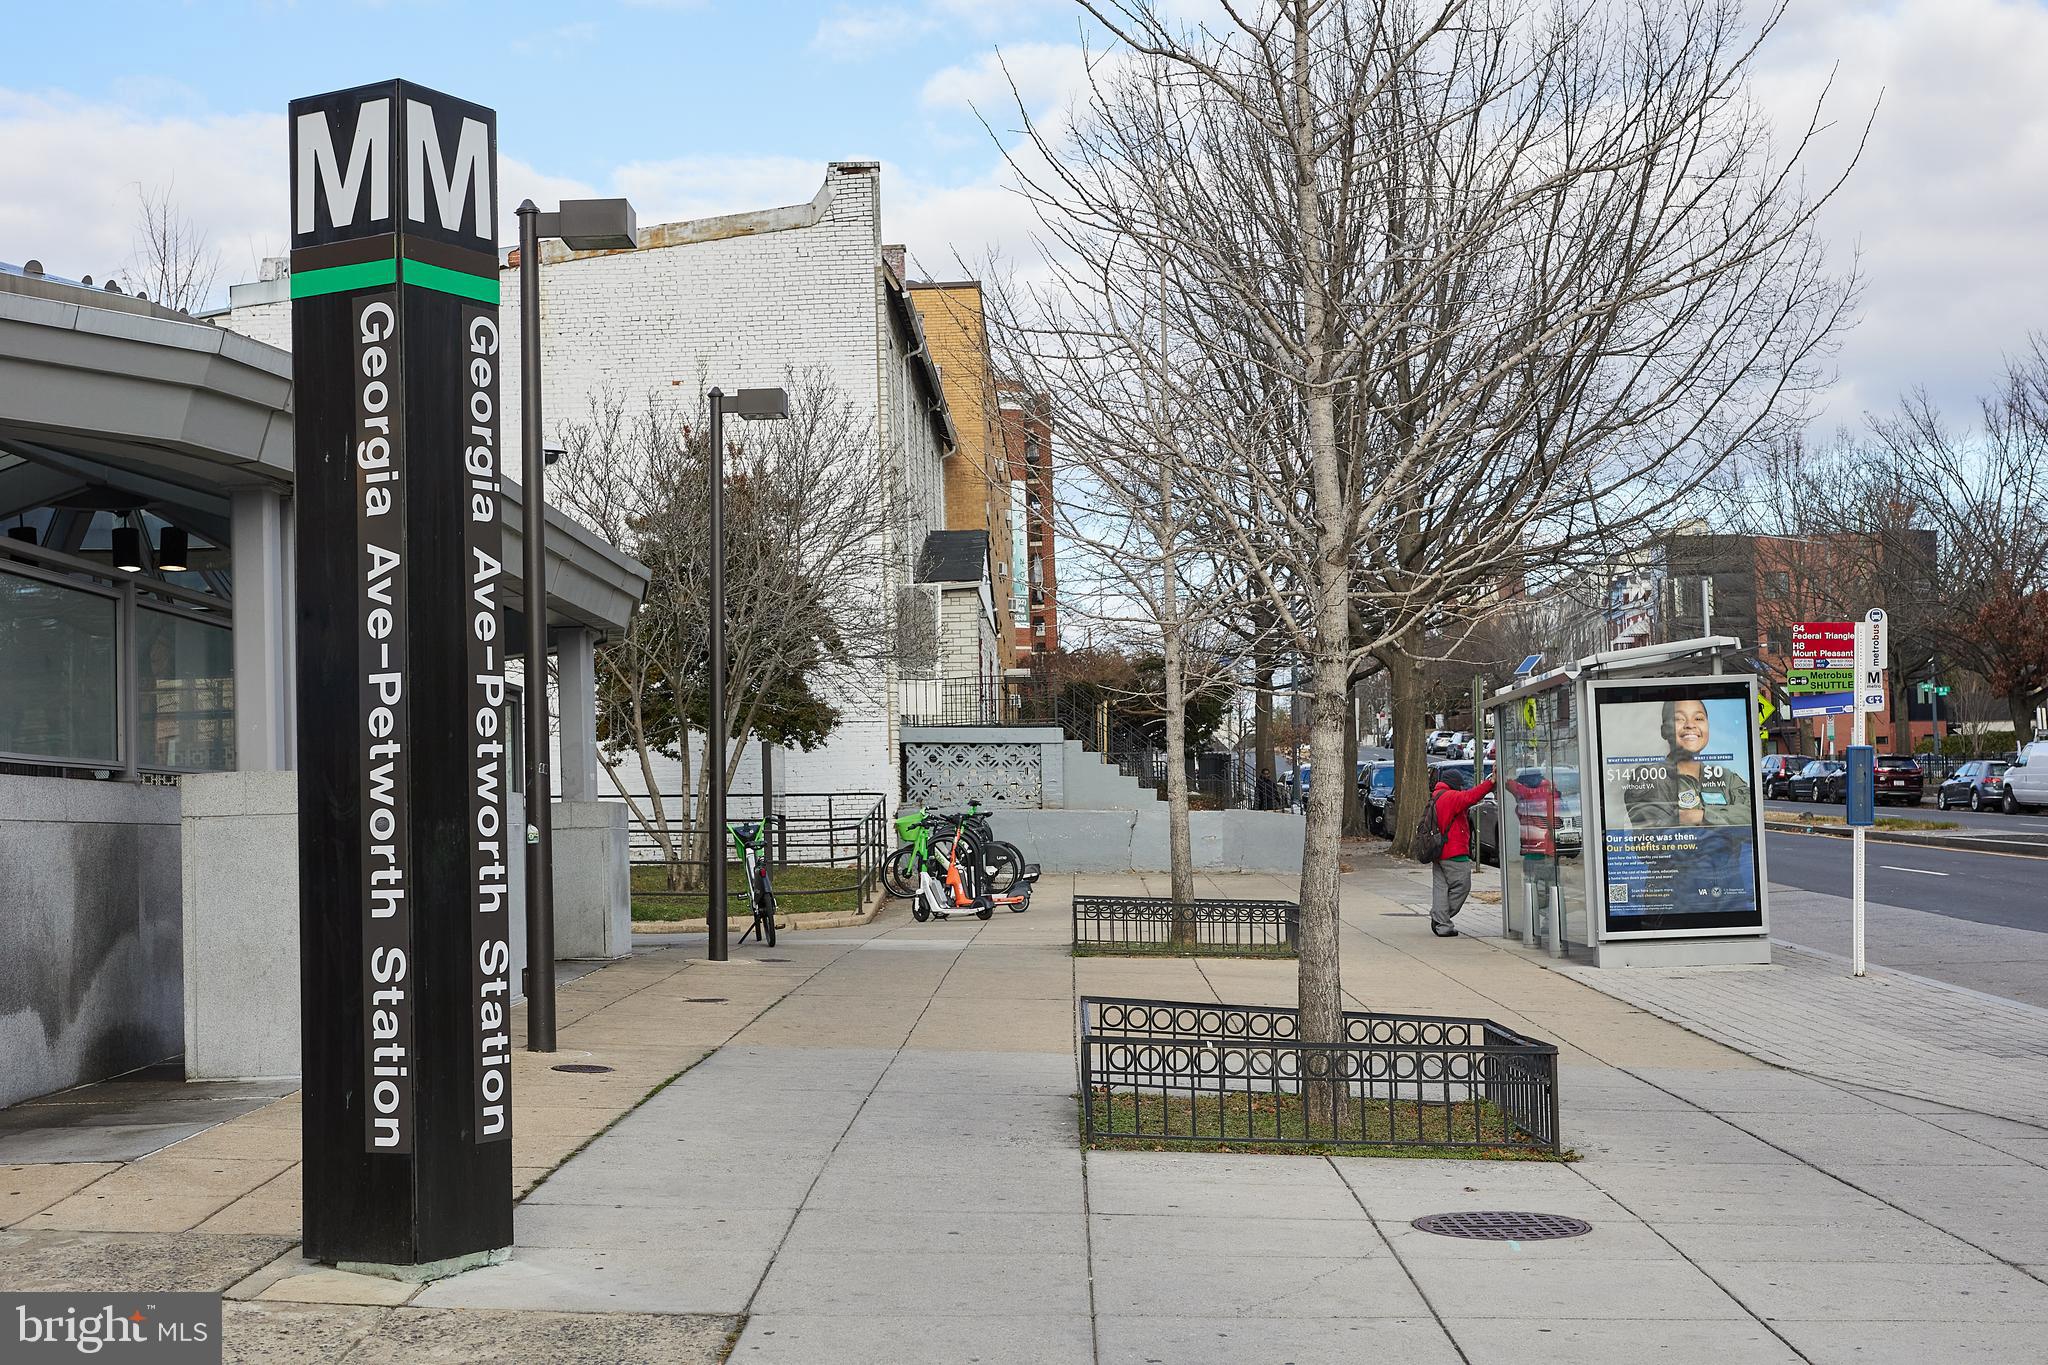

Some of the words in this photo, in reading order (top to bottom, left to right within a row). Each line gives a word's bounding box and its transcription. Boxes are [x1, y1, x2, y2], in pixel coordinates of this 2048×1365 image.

[298, 98, 390, 234] M
[406, 98, 492, 240] M
[357, 302, 400, 517] Georgia
[464, 315, 501, 523] Georgia
[1792, 624, 1804, 632] 64
[1824, 632, 1855, 640] Triangle
[1872, 624, 1880, 666] metrobus
[1810, 681, 1854, 689] SHUTTLE
[1868, 672, 1880, 683] M
[1607, 768, 1667, 782] $141,000
[1704, 765, 1723, 779] $0
[1625, 842, 1659, 851] benefits
[370, 946, 408, 1148] Station
[478, 939, 511, 1135] Station
